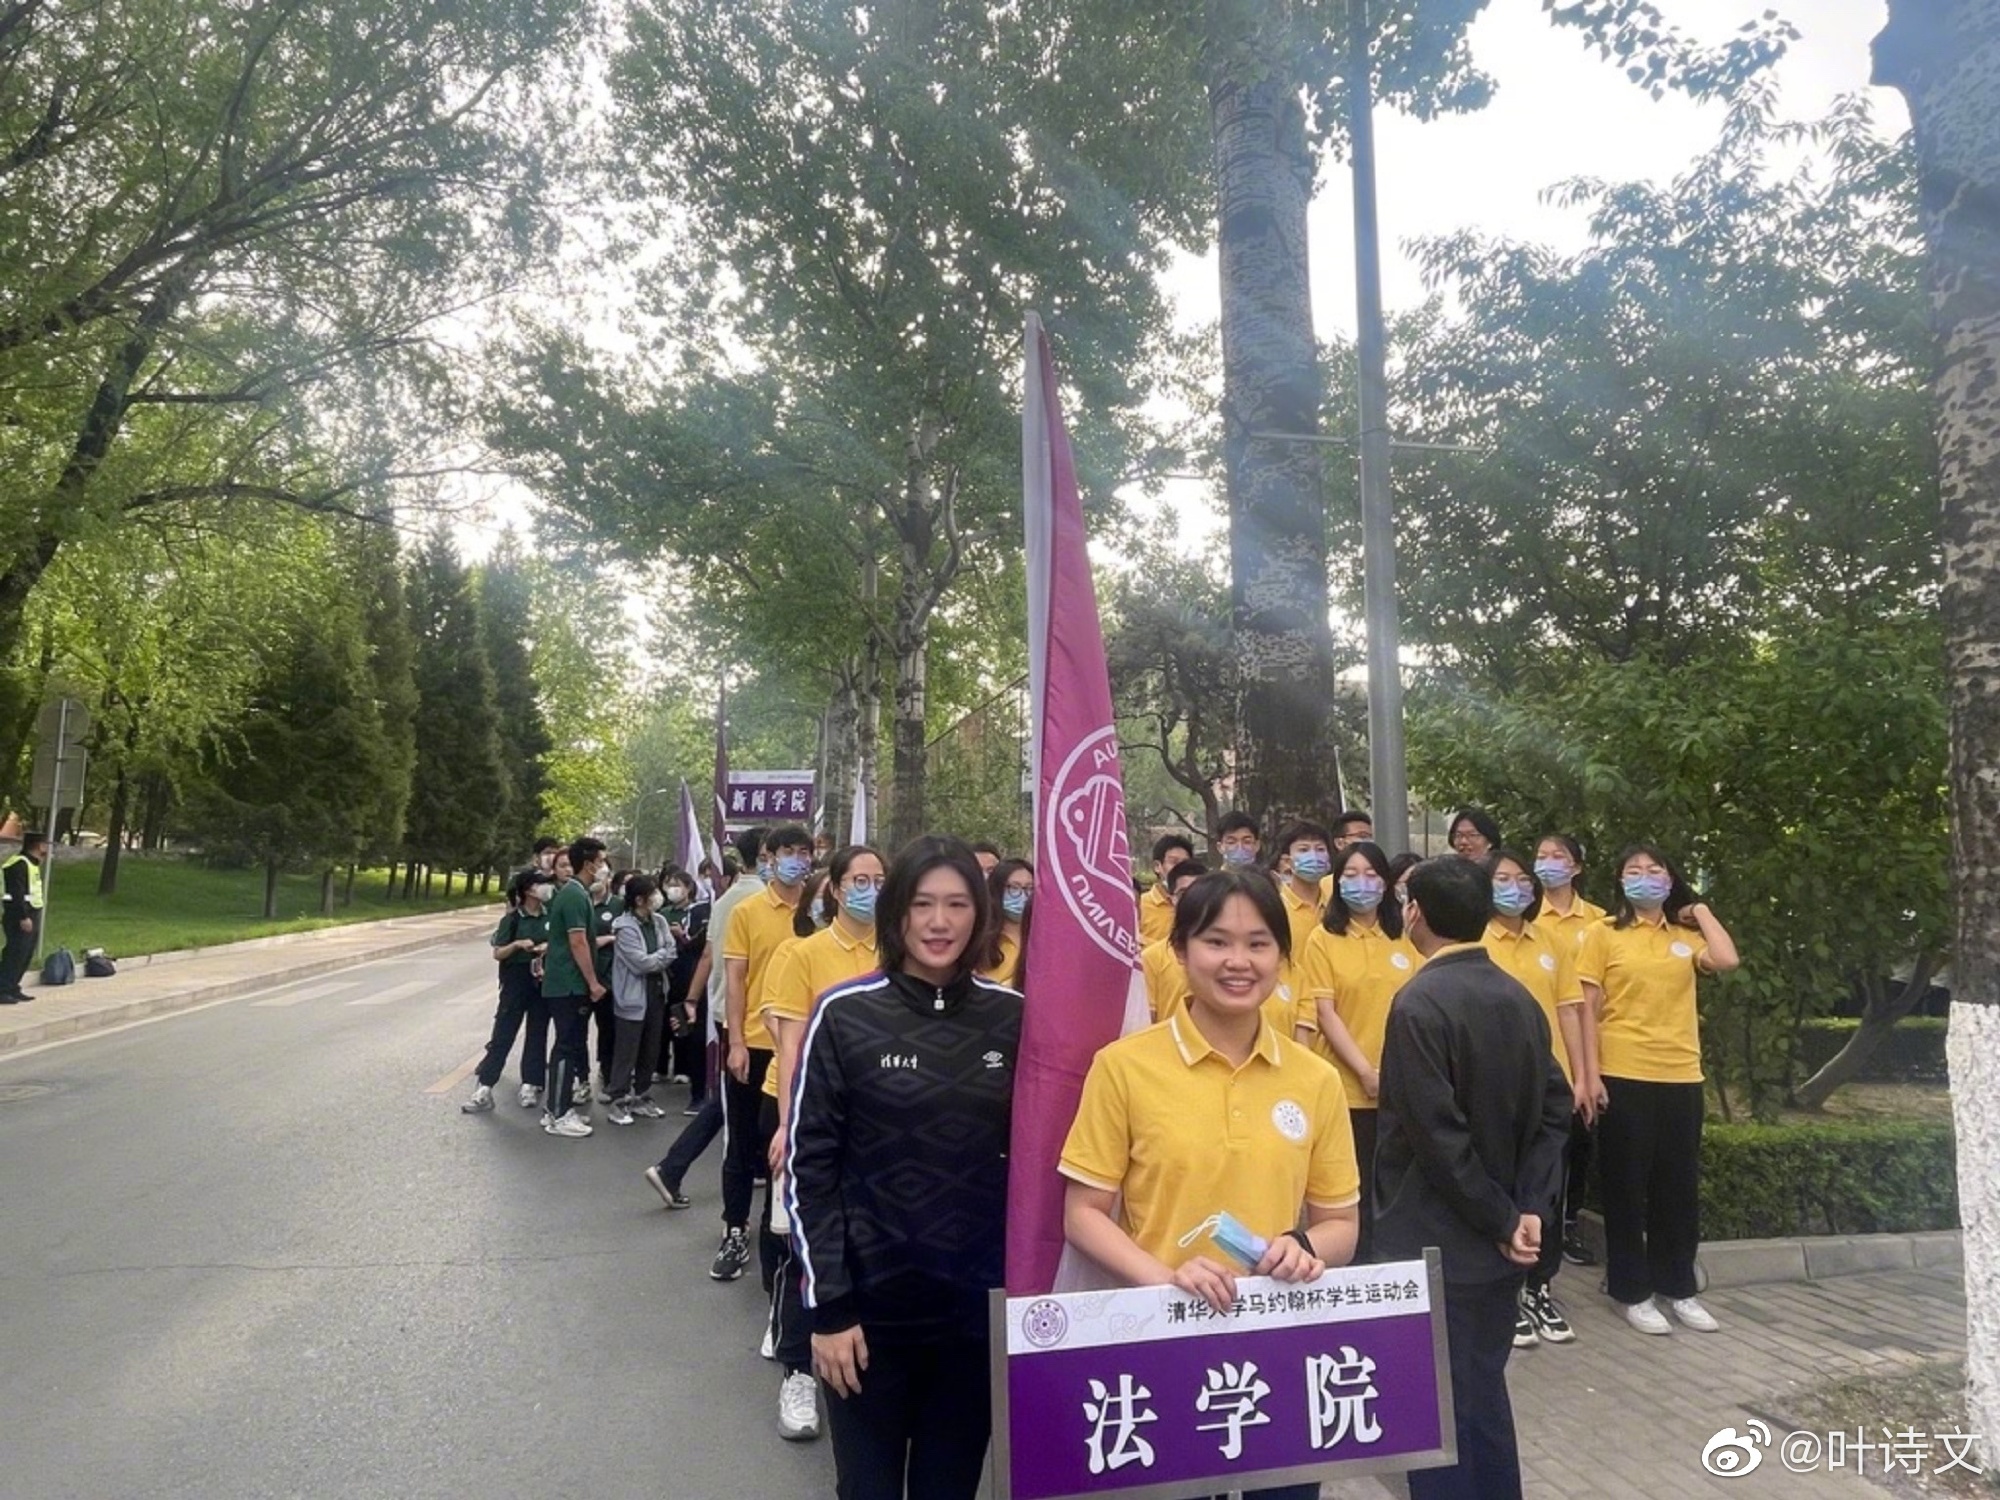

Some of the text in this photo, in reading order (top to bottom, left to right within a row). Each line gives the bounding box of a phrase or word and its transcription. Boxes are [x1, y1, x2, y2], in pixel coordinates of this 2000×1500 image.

[732, 788, 806, 812] 新闻学院
[1082, 1346, 1382, 1474] 法学院
